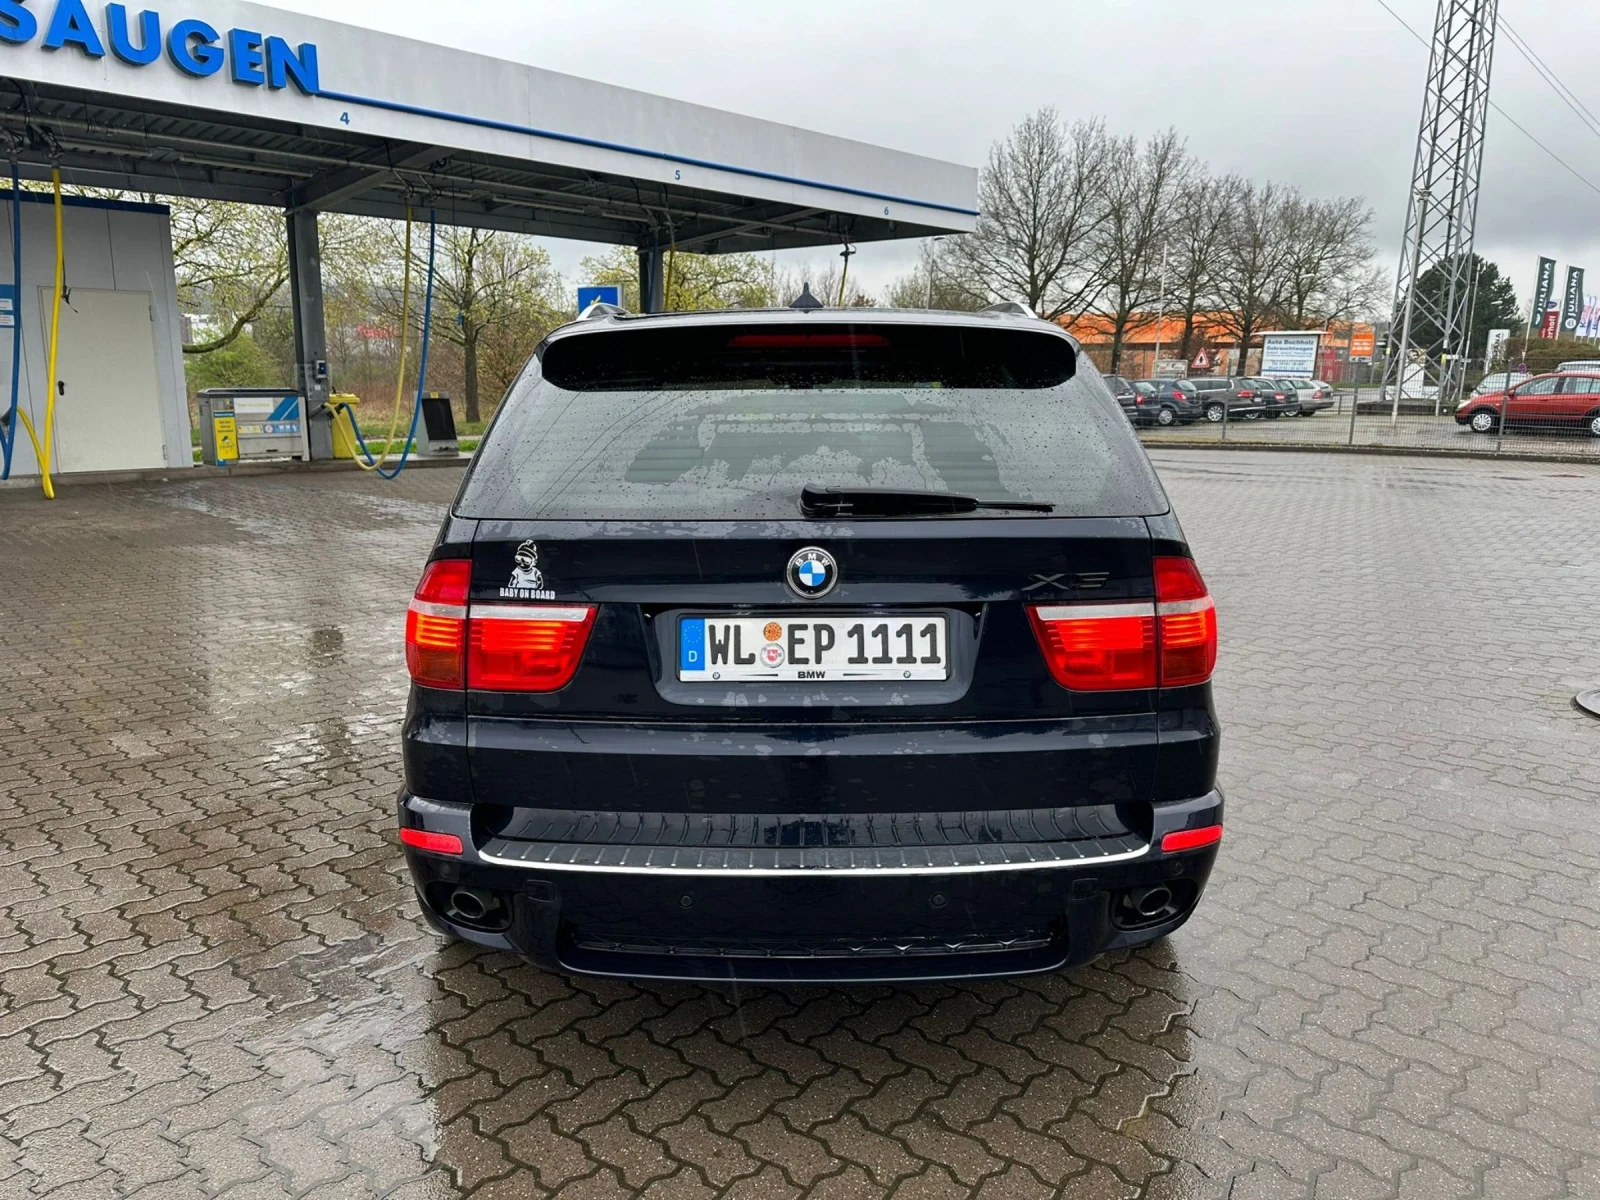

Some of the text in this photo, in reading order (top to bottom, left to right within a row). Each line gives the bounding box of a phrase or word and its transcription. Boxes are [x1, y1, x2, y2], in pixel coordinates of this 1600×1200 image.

[0, 0, 320, 95] SAUGEN
[340, 111, 350, 125] 4
[674, 169, 682, 181] 5
[883, 206, 890, 216] 6
[1537, 262, 1551, 312] JULIANA
[1567, 271, 1579, 317] JULIANA
[794, 552, 830, 567] BMW
[1020, 571, 1110, 591] X5
[500, 588, 555, 600] BABY ON BOARD
[708, 623, 942, 665] WL EP 1111
[688, 650, 698, 663] D
[797, 671, 826, 679] BMW
